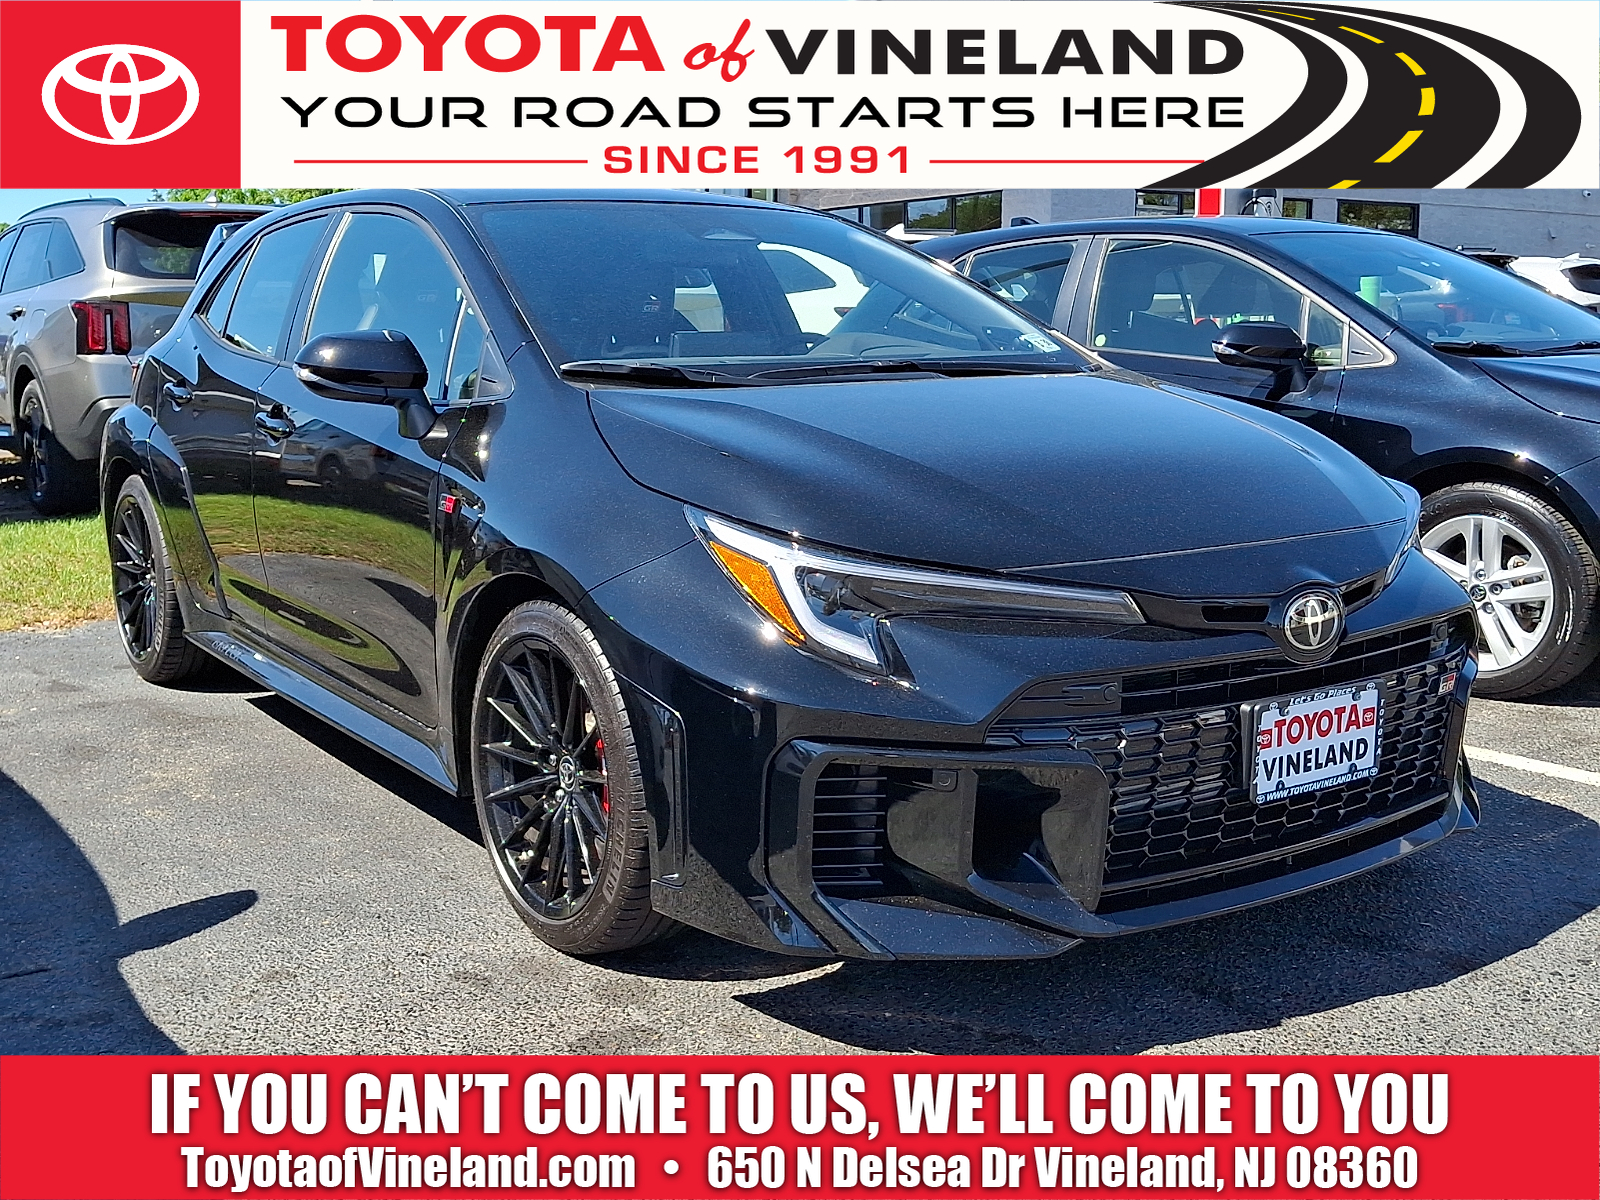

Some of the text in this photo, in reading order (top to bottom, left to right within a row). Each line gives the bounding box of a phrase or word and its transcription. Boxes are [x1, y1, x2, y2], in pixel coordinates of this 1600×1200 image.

[1289, 686, 1357, 706] Let's Go Places
[1439, 679, 1454, 693] GR
[1274, 703, 1361, 748] TOYOTA
[1376, 699, 1385, 755] TOYOTA
[1262, 737, 1369, 782] VINELAND
[1266, 768, 1370, 802] WWW.TOYOTAVINELAND.COM
